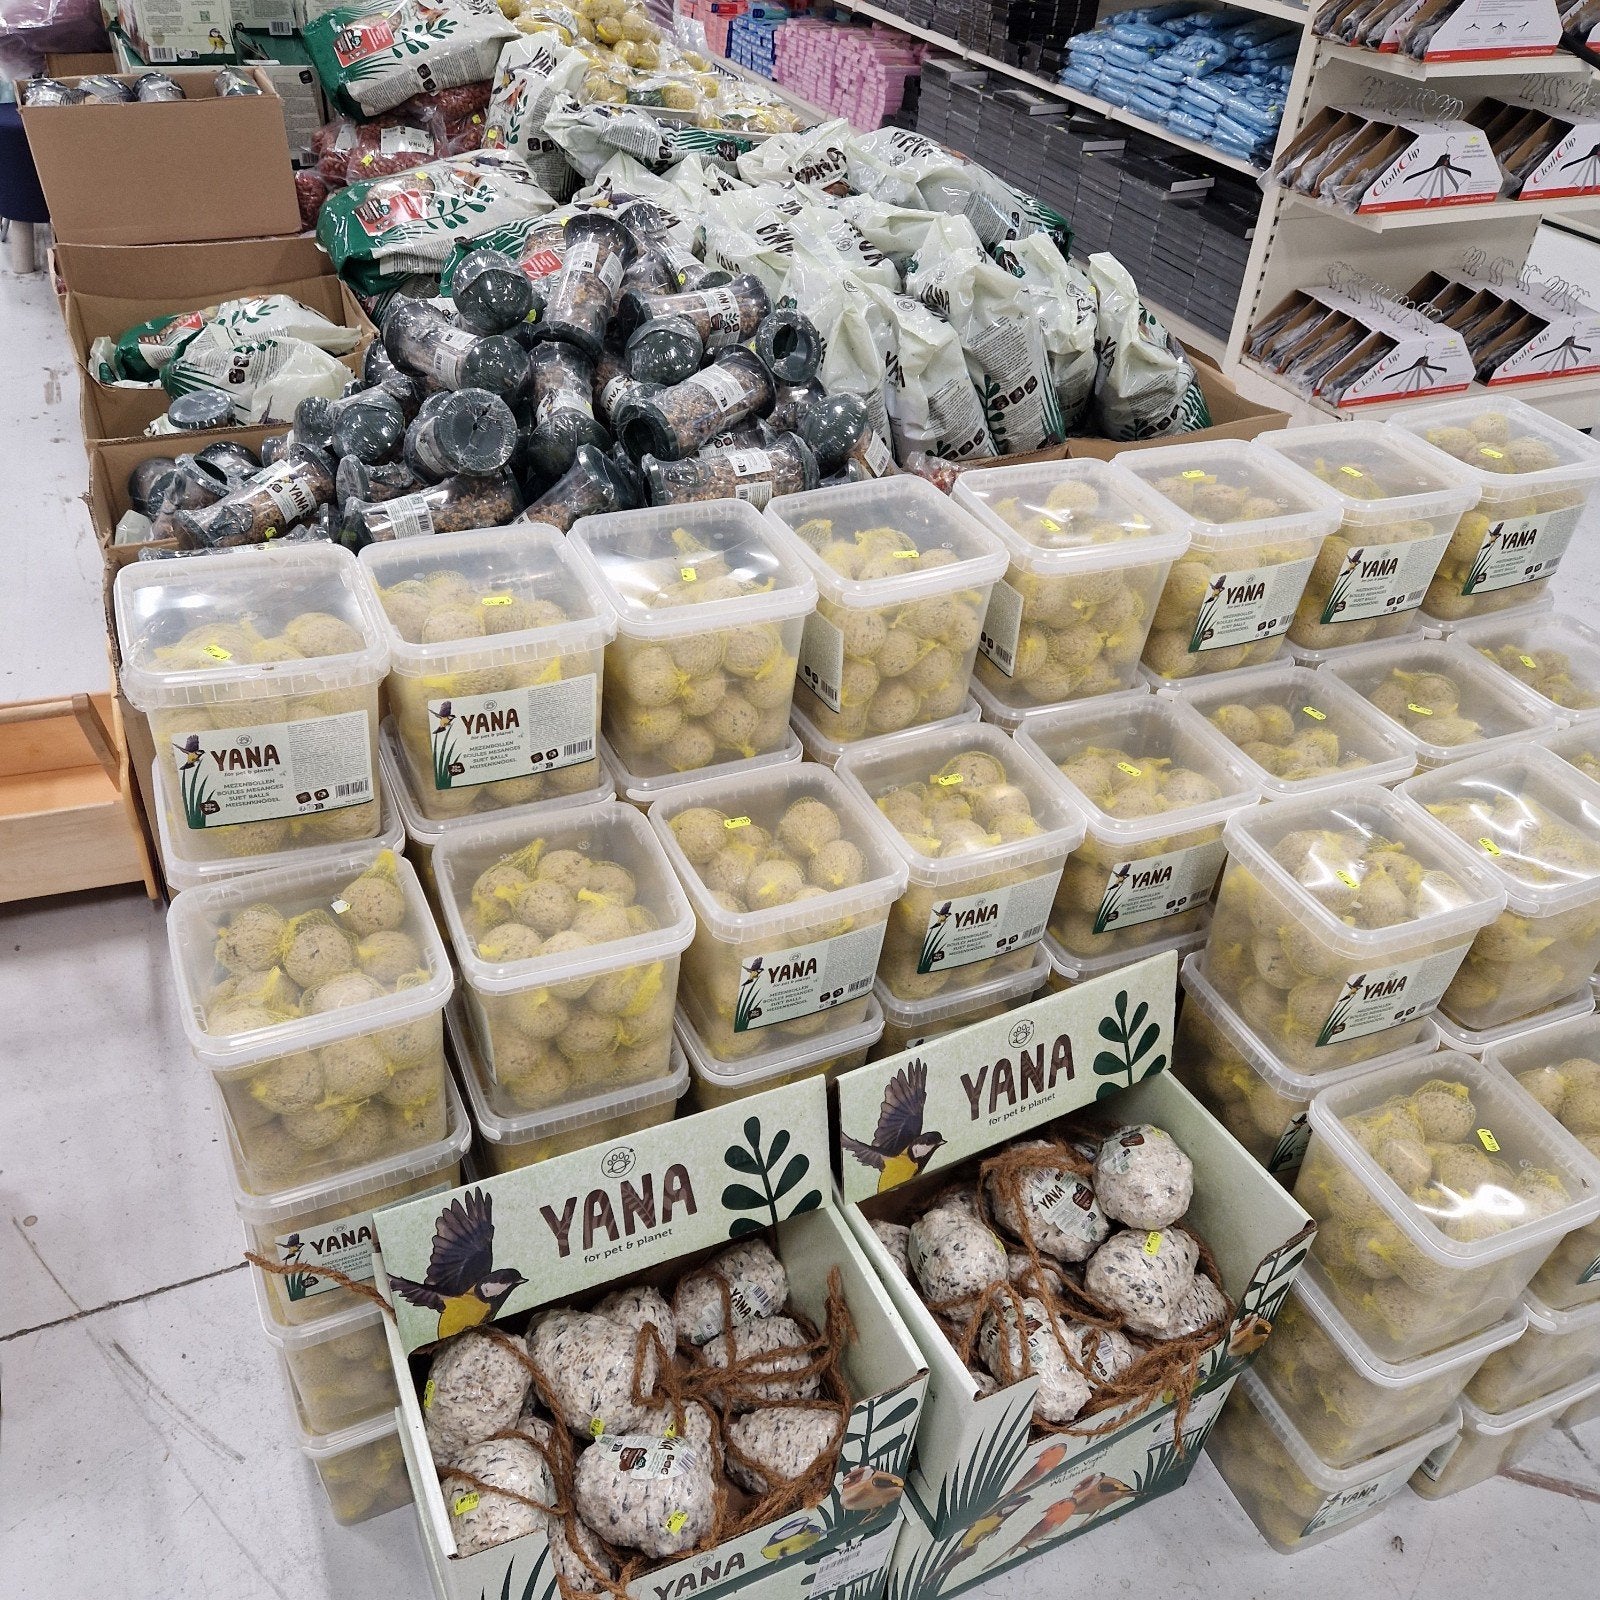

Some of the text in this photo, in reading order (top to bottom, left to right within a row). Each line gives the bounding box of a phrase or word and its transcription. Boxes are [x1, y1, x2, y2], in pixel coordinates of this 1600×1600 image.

[289, 484, 309, 512] YANA
[1501, 529, 1537, 550] YANA
[1361, 558, 1398, 578] YANA
[1227, 582, 1265, 604] YANA
[461, 708, 519, 735] YANA
[210, 744, 280, 772] YANA
[217, 784, 284, 796] BOULES MESANGES
[223, 779, 275, 788] MEZENBOLLEN
[248, 792, 270, 800] BALLS
[1132, 866, 1172, 888] YANA
[955, 903, 999, 928] YANA
[768, 958, 817, 983] YANA
[1363, 976, 1407, 1000] YANA
[960, 1034, 1075, 1121] YANA
[988, 1116, 1001, 1126] for
[1004, 1110, 1018, 1121] pet
[1028, 1093, 1056, 1111] planet
[539, 1163, 698, 1258] YANA
[310, 1226, 372, 1255] YANA
[584, 1228, 673, 1263] for pet & planet
[731, 1288, 751, 1319] YANA
[1341, 1484, 1379, 1505] YANA
[653, 1552, 745, 1600] YANA
